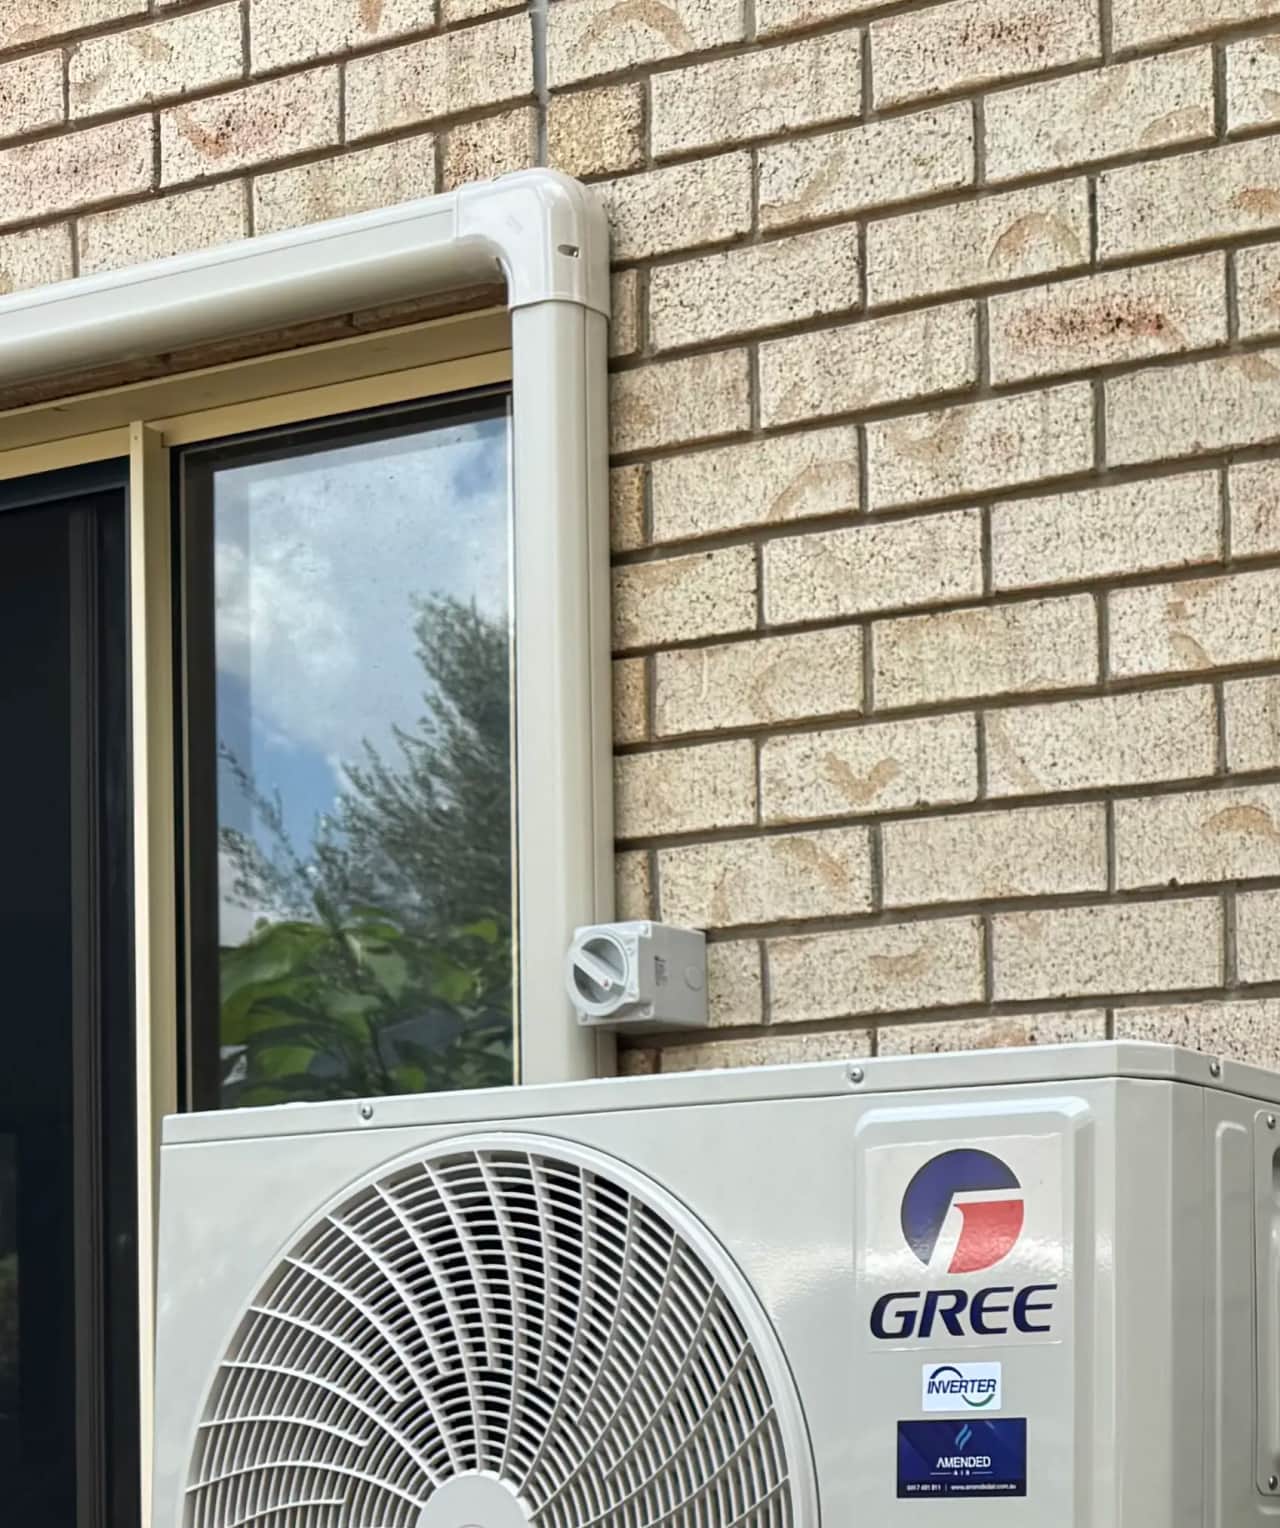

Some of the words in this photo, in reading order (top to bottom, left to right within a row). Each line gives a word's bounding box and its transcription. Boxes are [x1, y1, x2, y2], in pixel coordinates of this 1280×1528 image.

[870, 1284, 1058, 1339] GREE
[927, 1378, 997, 1394] INVERTER
[936, 1456, 992, 1469] AMENDED
